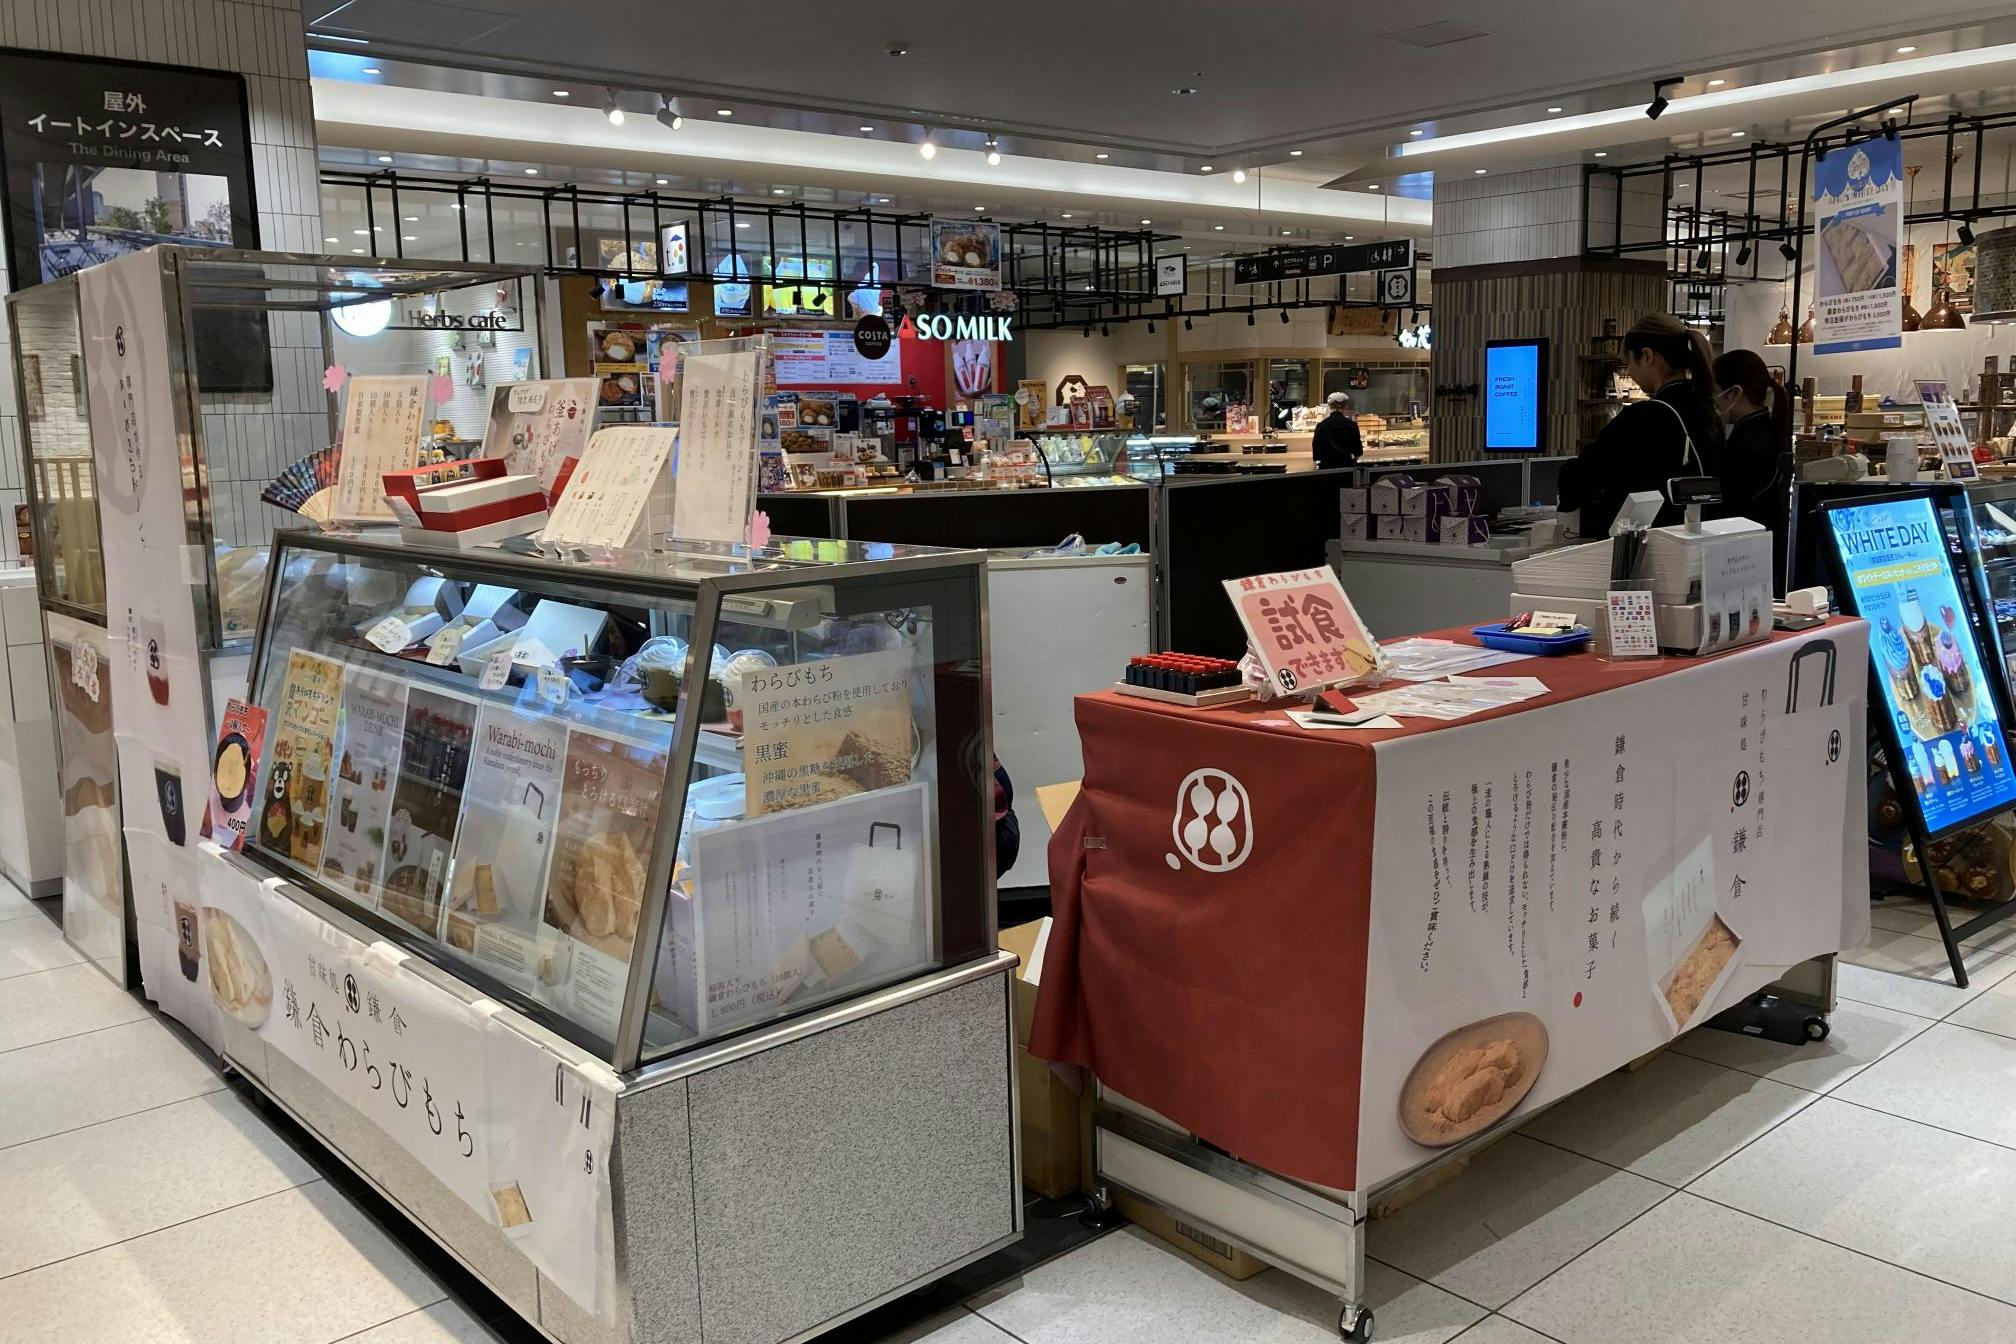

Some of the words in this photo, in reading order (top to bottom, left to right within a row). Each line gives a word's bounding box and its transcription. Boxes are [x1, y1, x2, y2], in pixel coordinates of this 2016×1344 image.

[103, 91, 147, 114] 屋外
[27, 114, 224, 148] イートインスペース
[70, 142, 99, 157] The
[102, 145, 151, 162] Dining
[155, 149, 190, 165] Area
[408, 310, 464, 328] Herbs
[956, 310, 1013, 341] MILK
[858, 330, 889, 342] COSTA
[1240, 570, 1323, 592] 鎌倉わらびもち
[1259, 593, 1345, 652] 試食
[751, 665, 833, 693] わらびもち
[1288, 646, 1346, 679] できます
[758, 680, 908, 715] 国産の本わらび粉を使用しており
[759, 706, 854, 731] モッチリとした食感
[488, 724, 556, 760] Warabi-mochi
[755, 741, 788, 764] 黒蜜
[1755, 688, 1768, 839] わらびもち専門店
[227, 816, 248, 836] 400円
[1609, 734, 1626, 949] 鎌倉時代から続く
[1729, 827, 1747, 898] 鎌倉
[1585, 819, 1602, 980] 高貴なお菓子
[306, 954, 340, 994] 甘味処
[366, 990, 407, 1037] 鎌倉
[283, 978, 473, 1158] 鎌倉わらびもち
